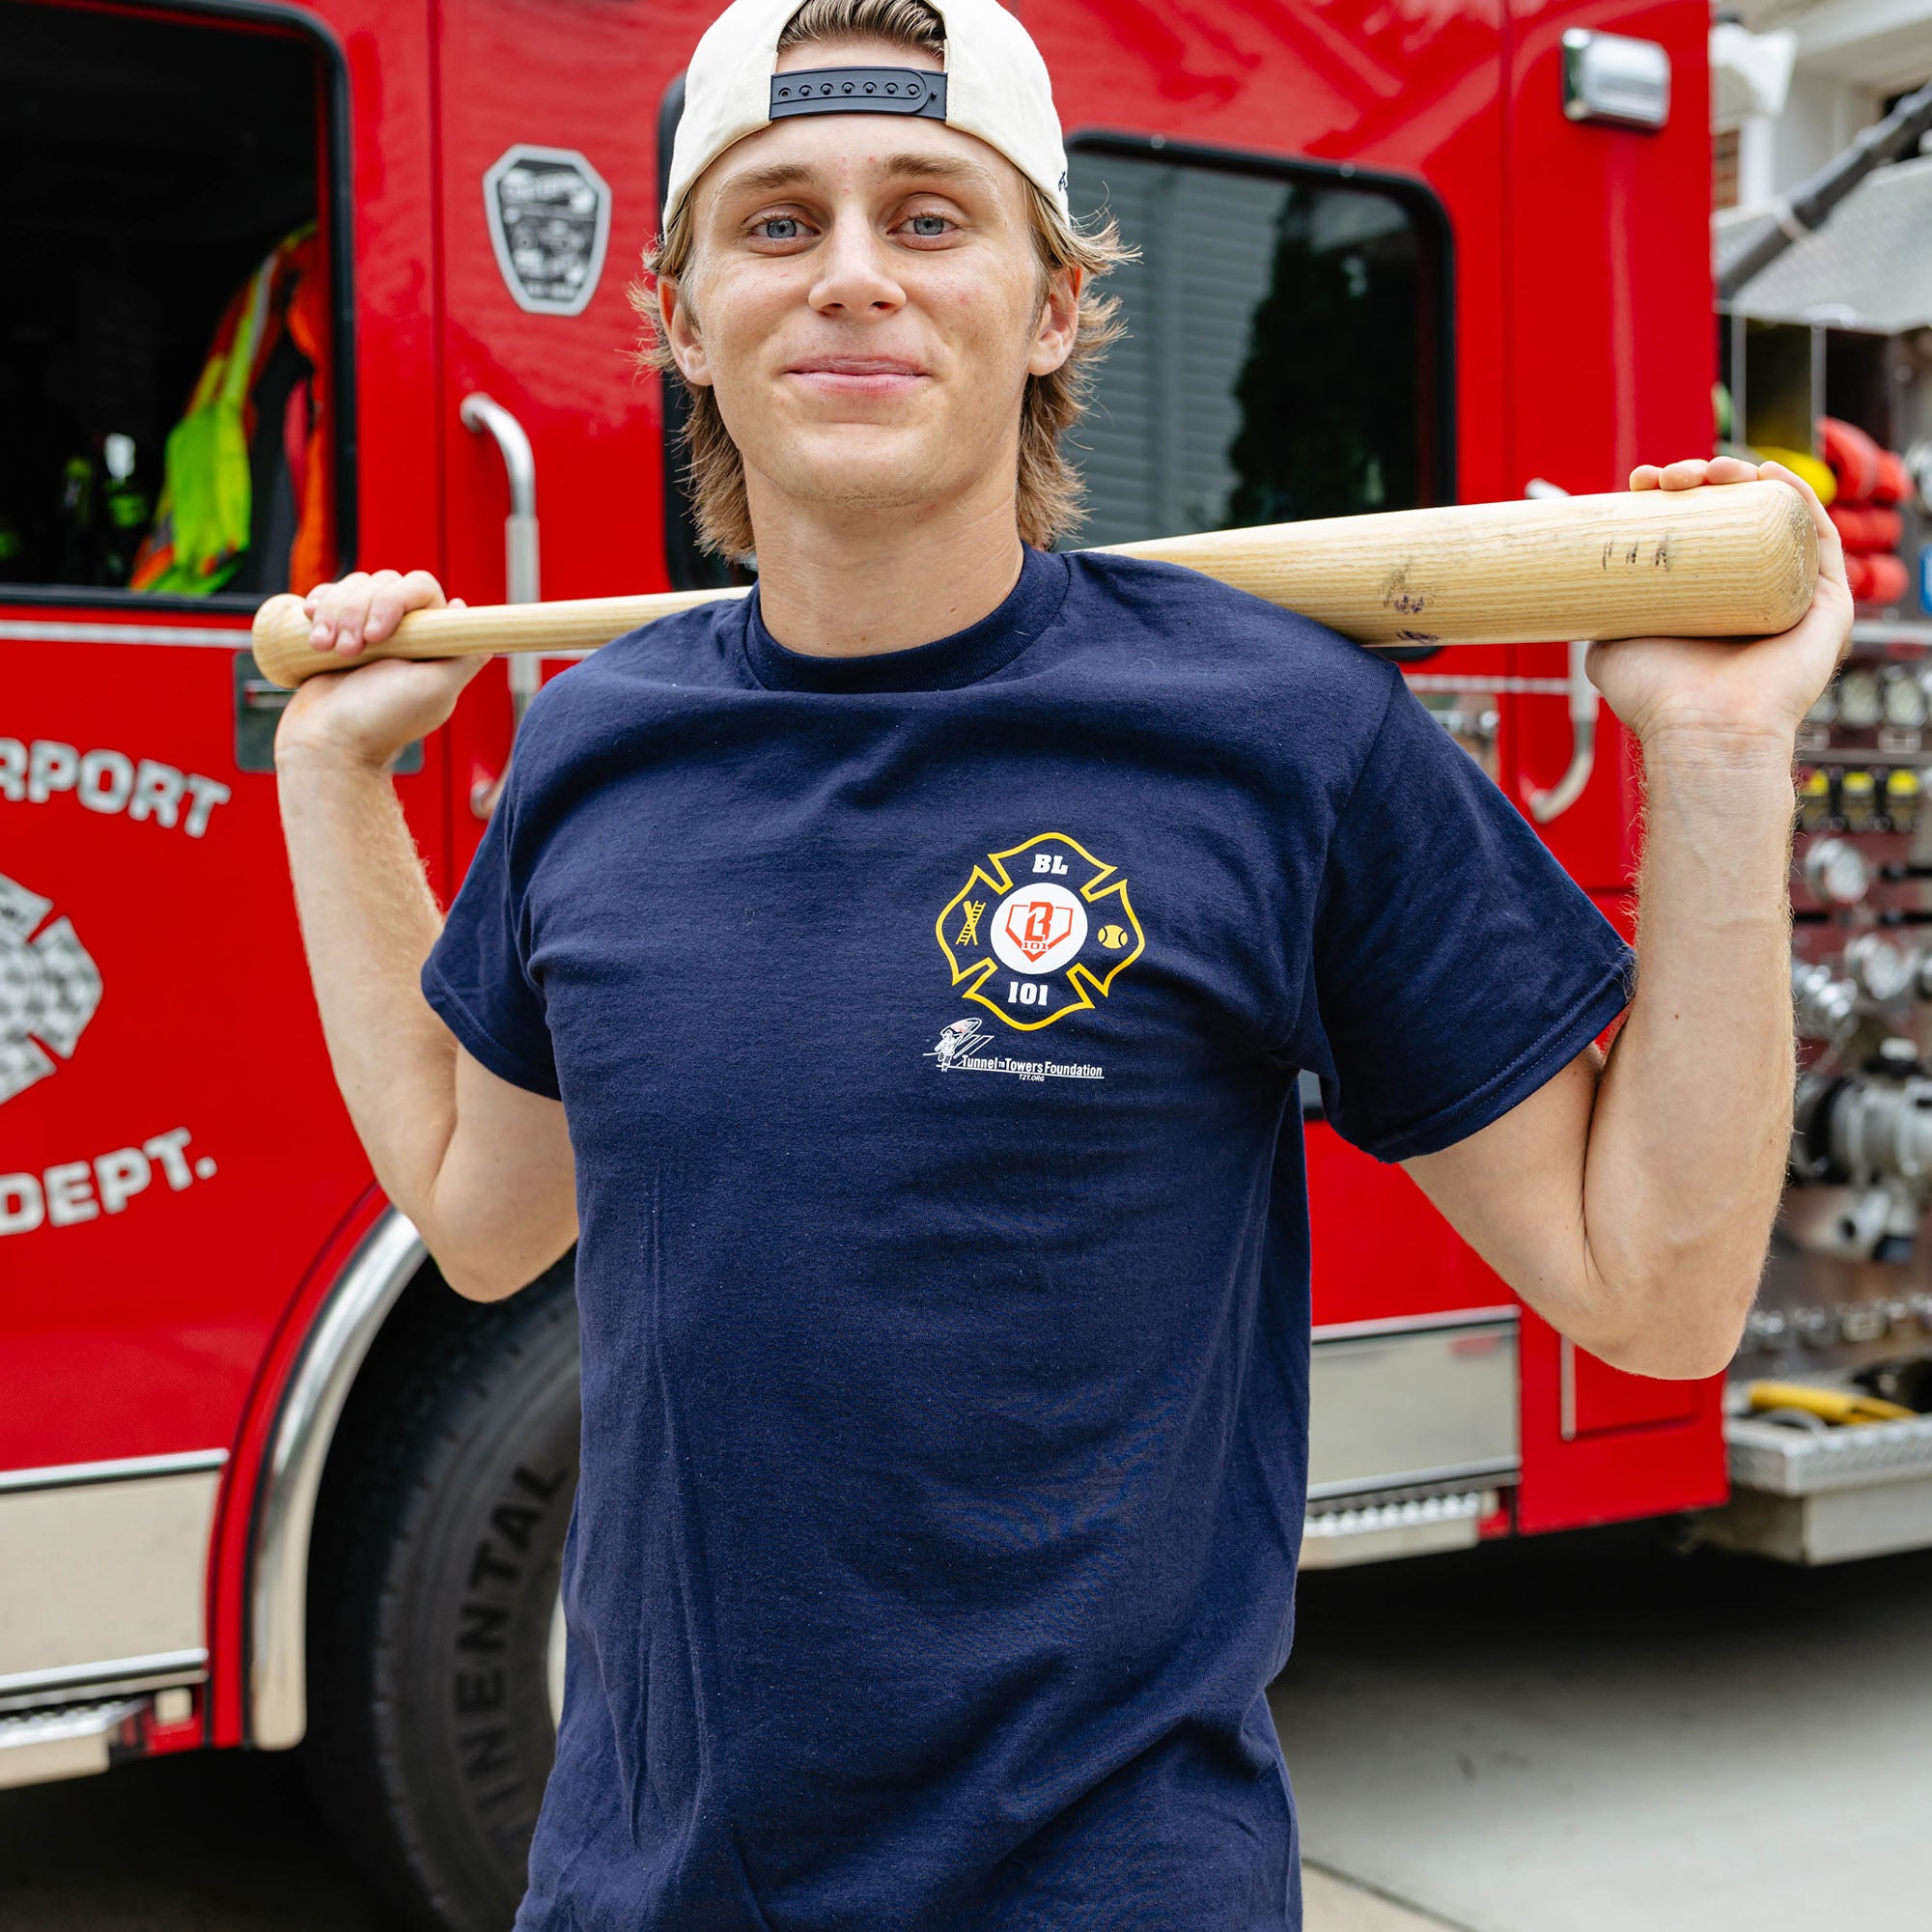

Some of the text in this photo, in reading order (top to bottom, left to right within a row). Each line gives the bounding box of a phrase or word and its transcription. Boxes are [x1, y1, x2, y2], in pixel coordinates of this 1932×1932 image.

[1032, 854, 1068, 875] BL
[1022, 941, 1048, 950] 101
[1008, 981, 1049, 1006] 101
[962, 1054, 998, 1070] Tunnel
[1005, 1058, 1044, 1073] Towers
[1045, 1061, 1103, 1078] Foundation
[1019, 1074, 1045, 1082] T2T.ORG
[0, 1126, 218, 1237] DEPT.
